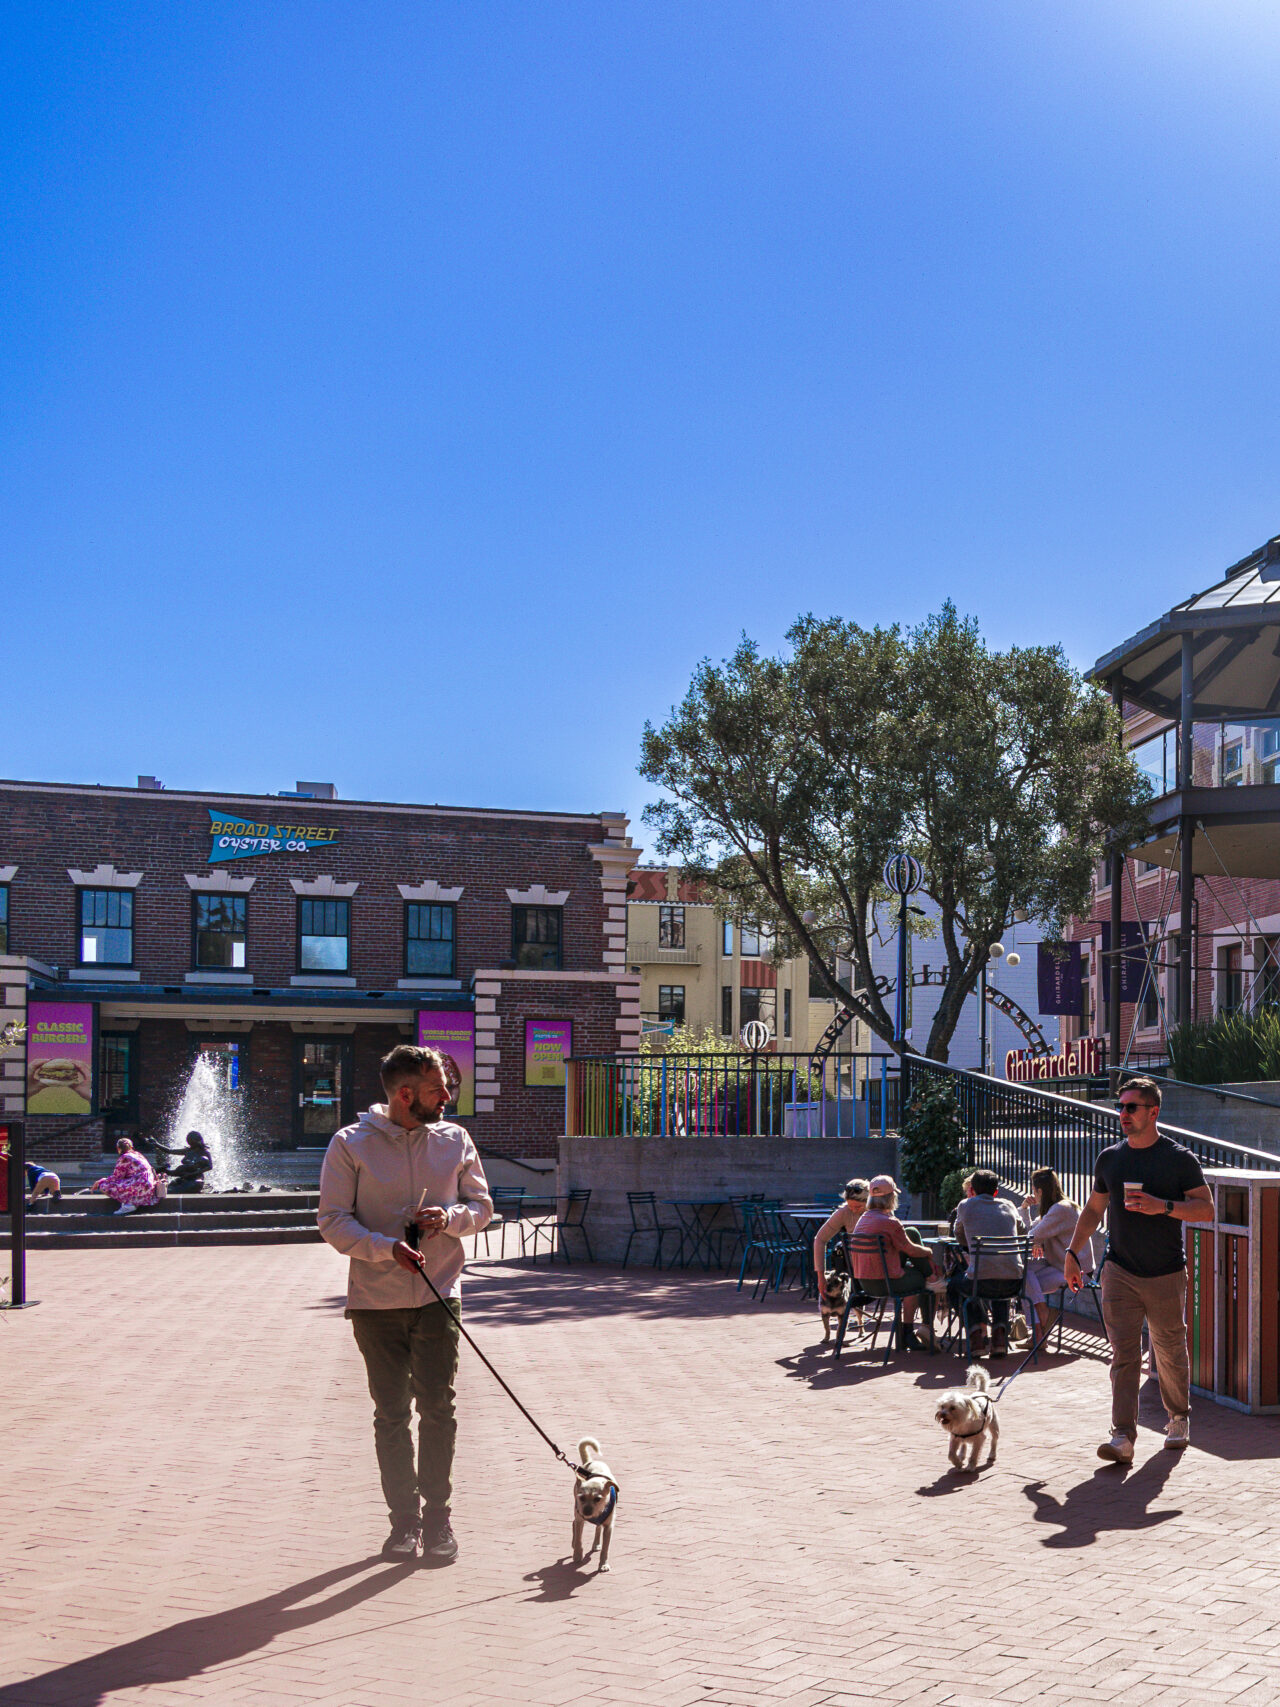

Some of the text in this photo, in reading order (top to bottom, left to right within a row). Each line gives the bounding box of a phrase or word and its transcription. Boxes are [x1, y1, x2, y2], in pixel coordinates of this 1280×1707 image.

[210, 821, 340, 841] BROAD STREET
[218, 836, 310, 854] OYSTER CO.
[36, 1022, 84, 1033] CLASSIC
[31, 1033, 88, 1044] BURGERS
[534, 1043, 562, 1052] NOW
[532, 1052, 564, 1061] OPEN!
[1005, 1037, 1097, 1081] Ghirardelli
